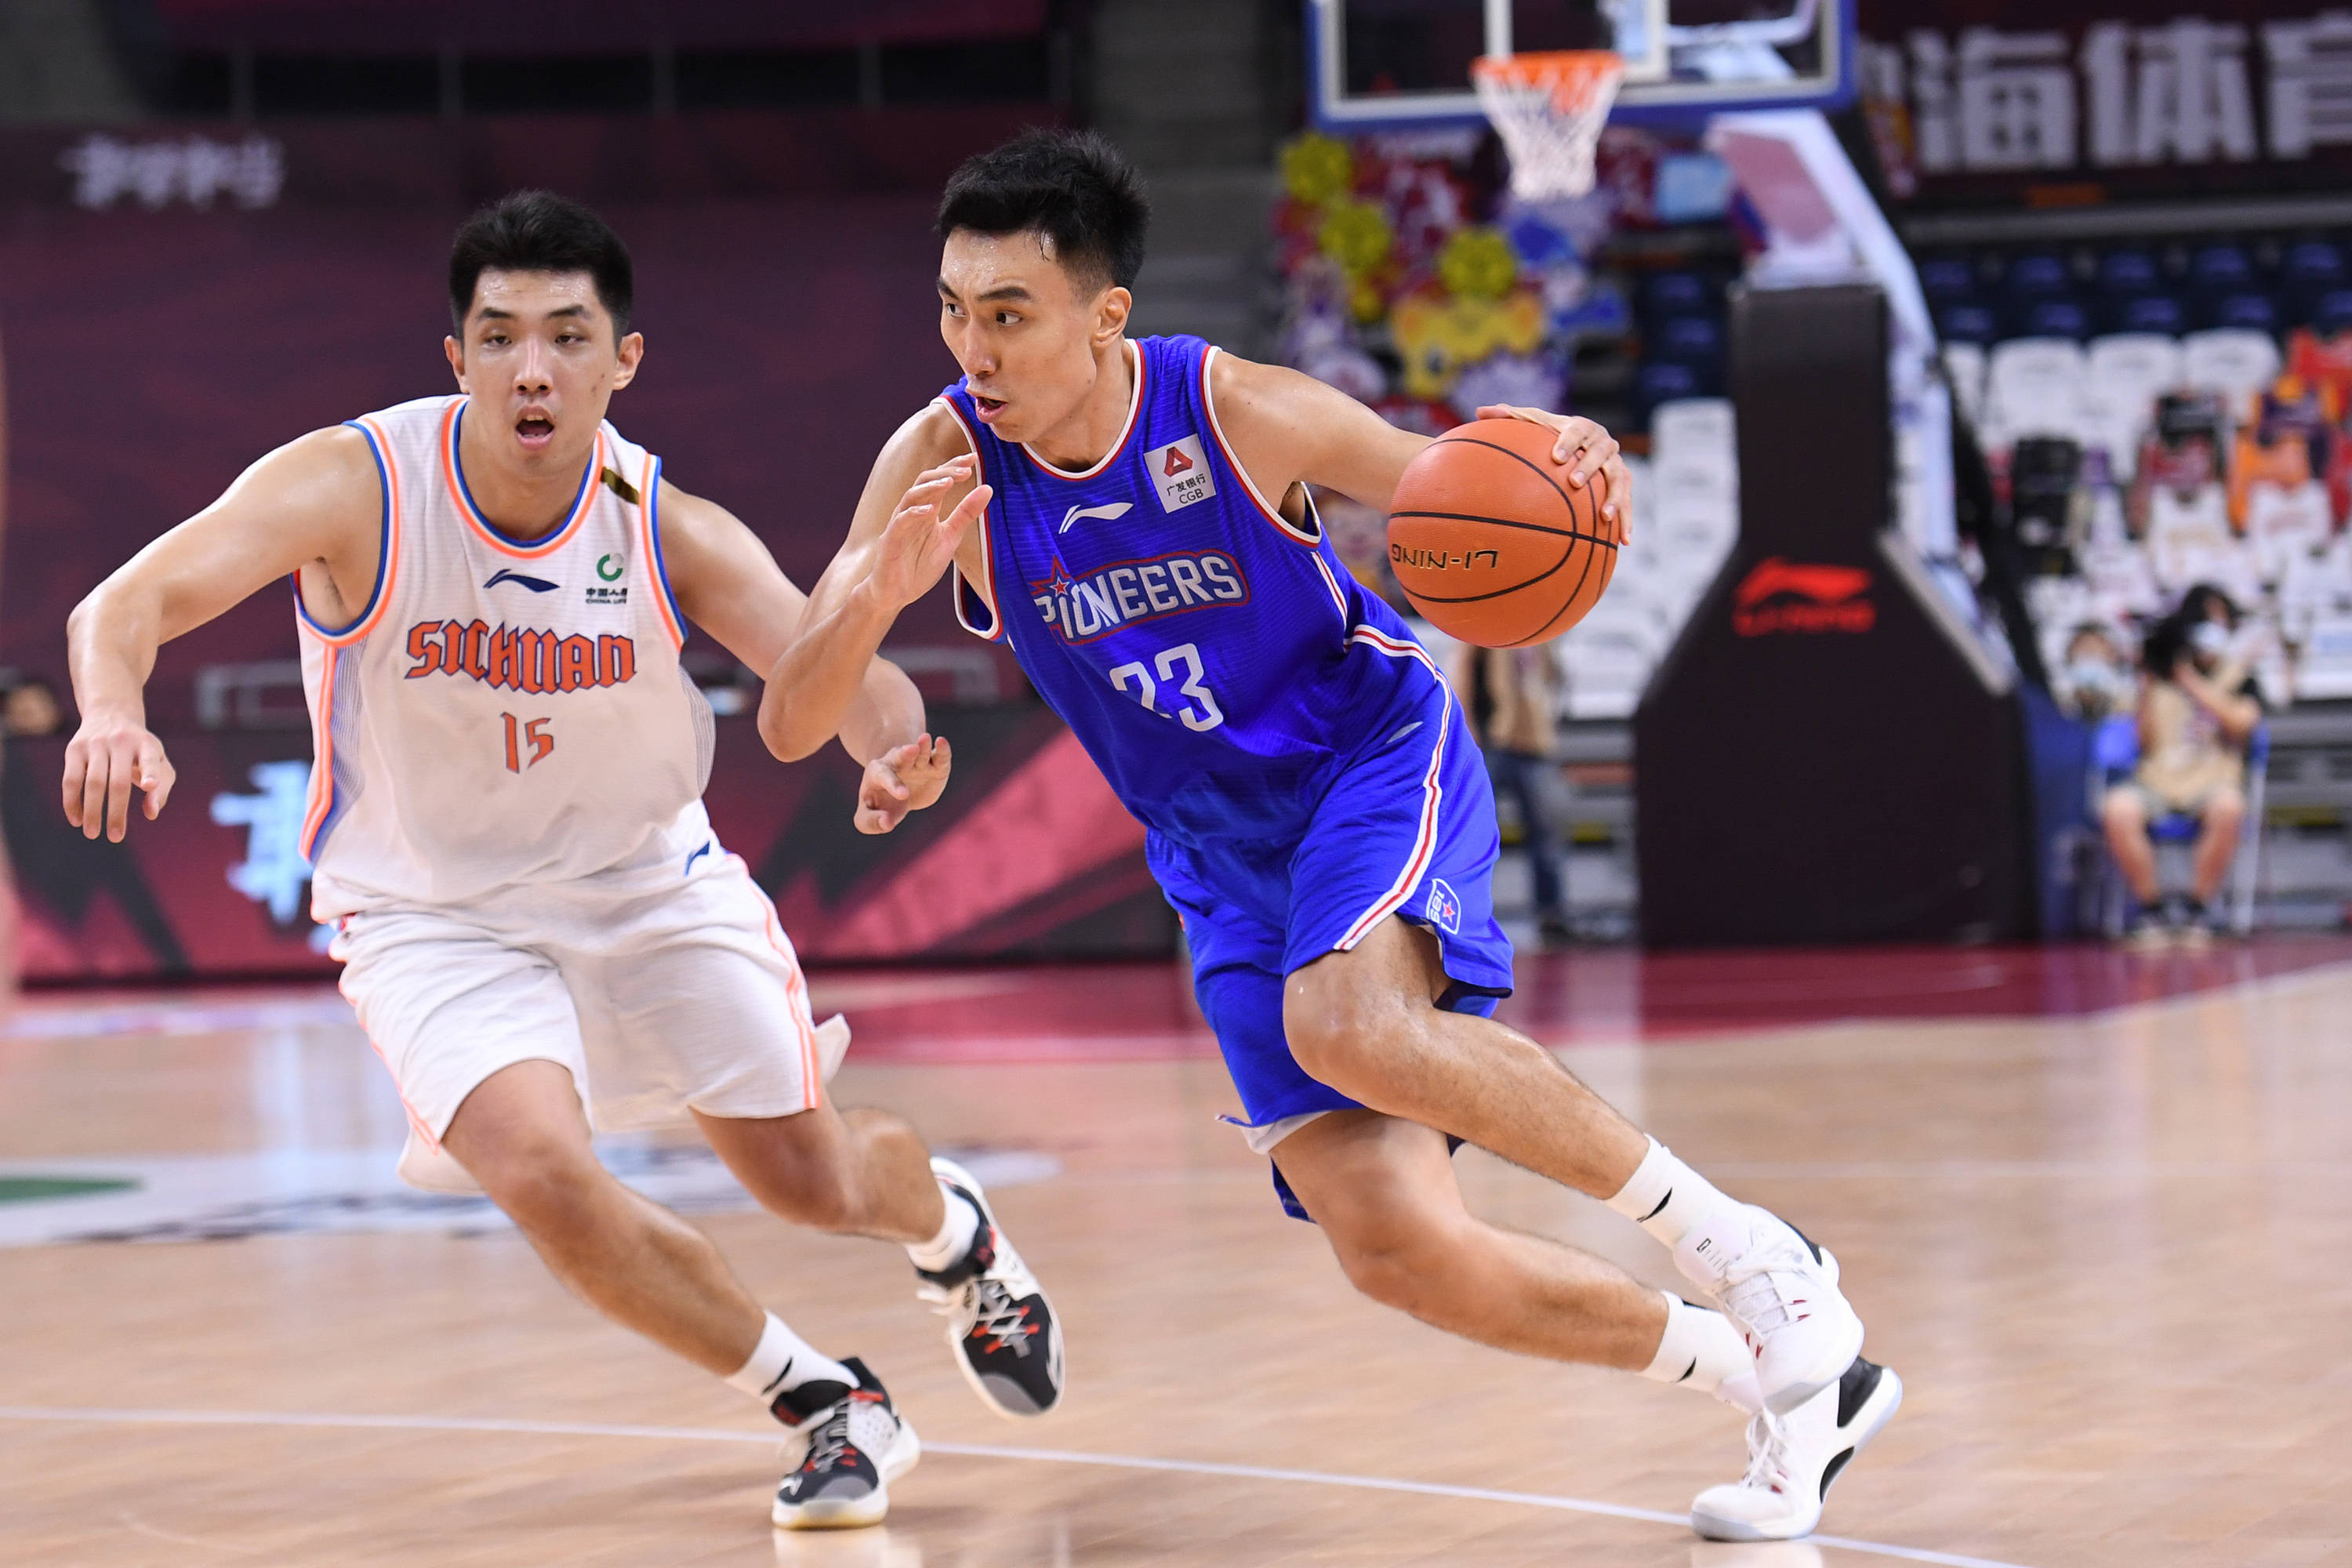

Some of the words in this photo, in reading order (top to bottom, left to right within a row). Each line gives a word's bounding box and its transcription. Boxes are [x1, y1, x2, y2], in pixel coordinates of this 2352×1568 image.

[1858, 13, 2352, 174] 海体育
[1167, 474, 1206, 496] 广发银行
[1179, 488, 1203, 504] CGB
[1391, 543, 1499, 570] LI-NING
[1033, 555, 1243, 640] PIONEERS
[404, 619, 637, 695] SICHUAN
[1109, 643, 1224, 732] 23
[500, 711, 554, 775] 15
